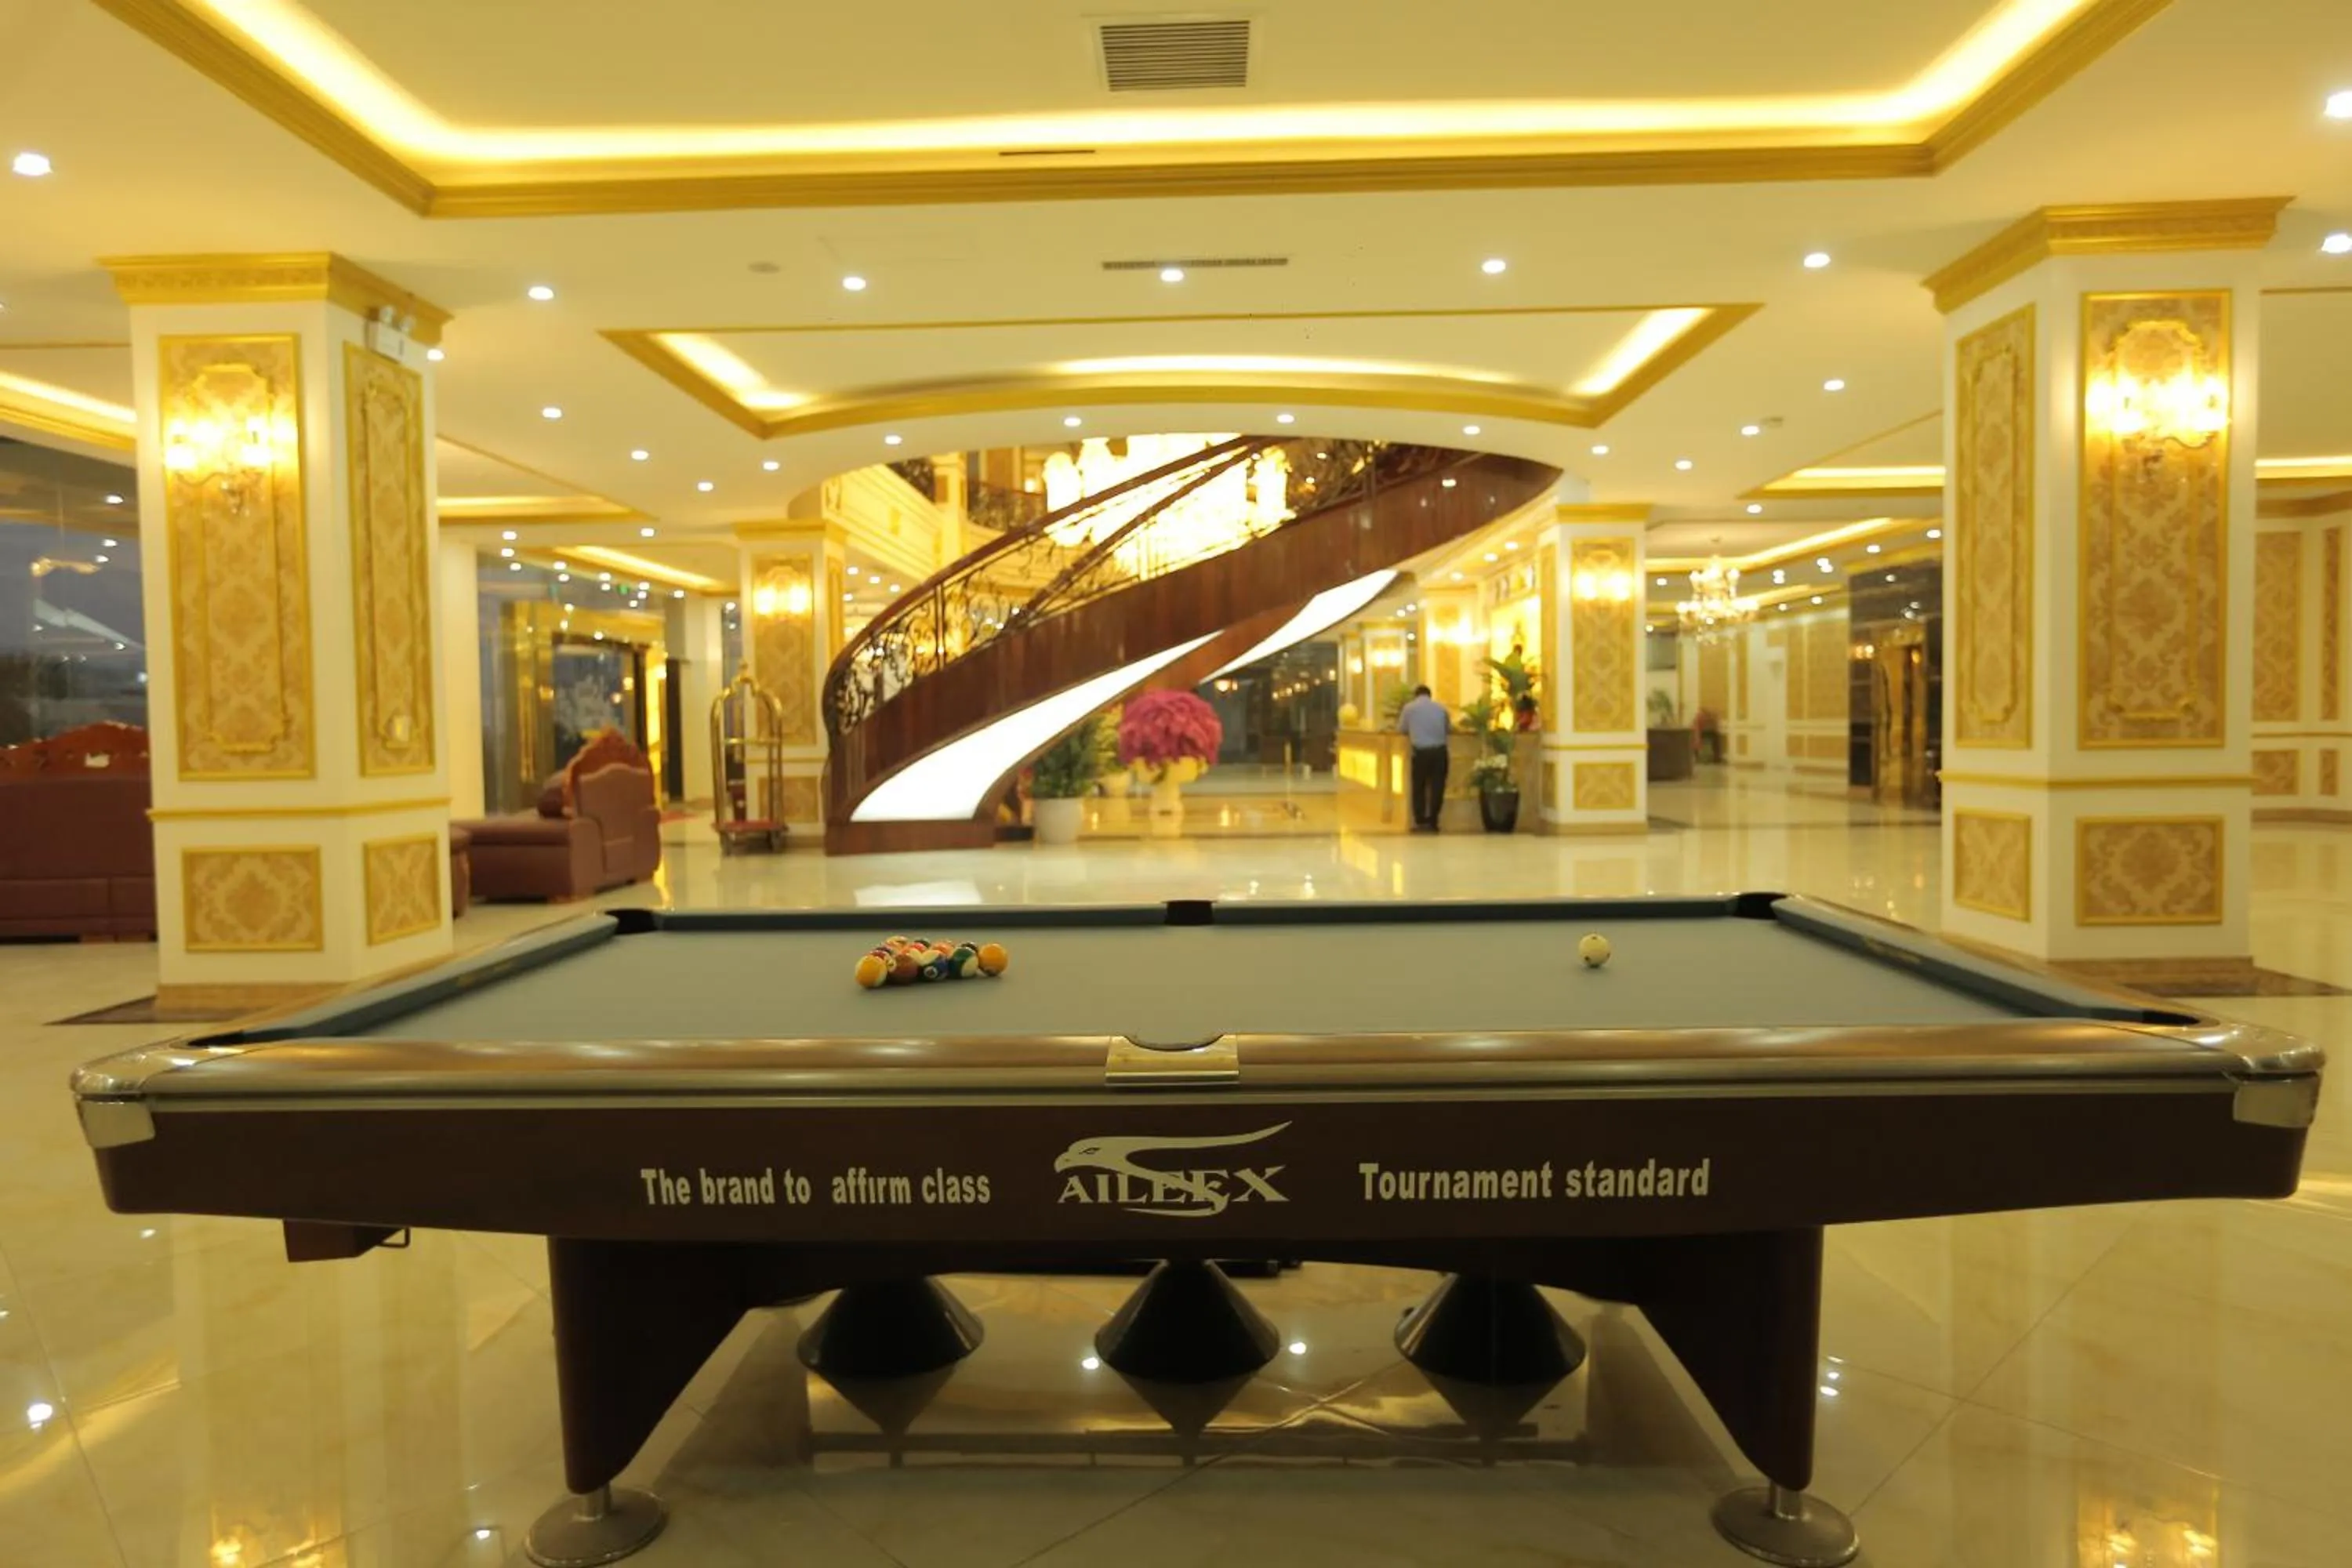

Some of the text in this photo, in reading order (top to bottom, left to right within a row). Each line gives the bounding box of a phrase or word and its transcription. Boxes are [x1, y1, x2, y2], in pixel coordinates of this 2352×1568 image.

[641, 1167, 990, 1205] The brand to affirm class
[1359, 1158, 1710, 1200] Tournament standard
